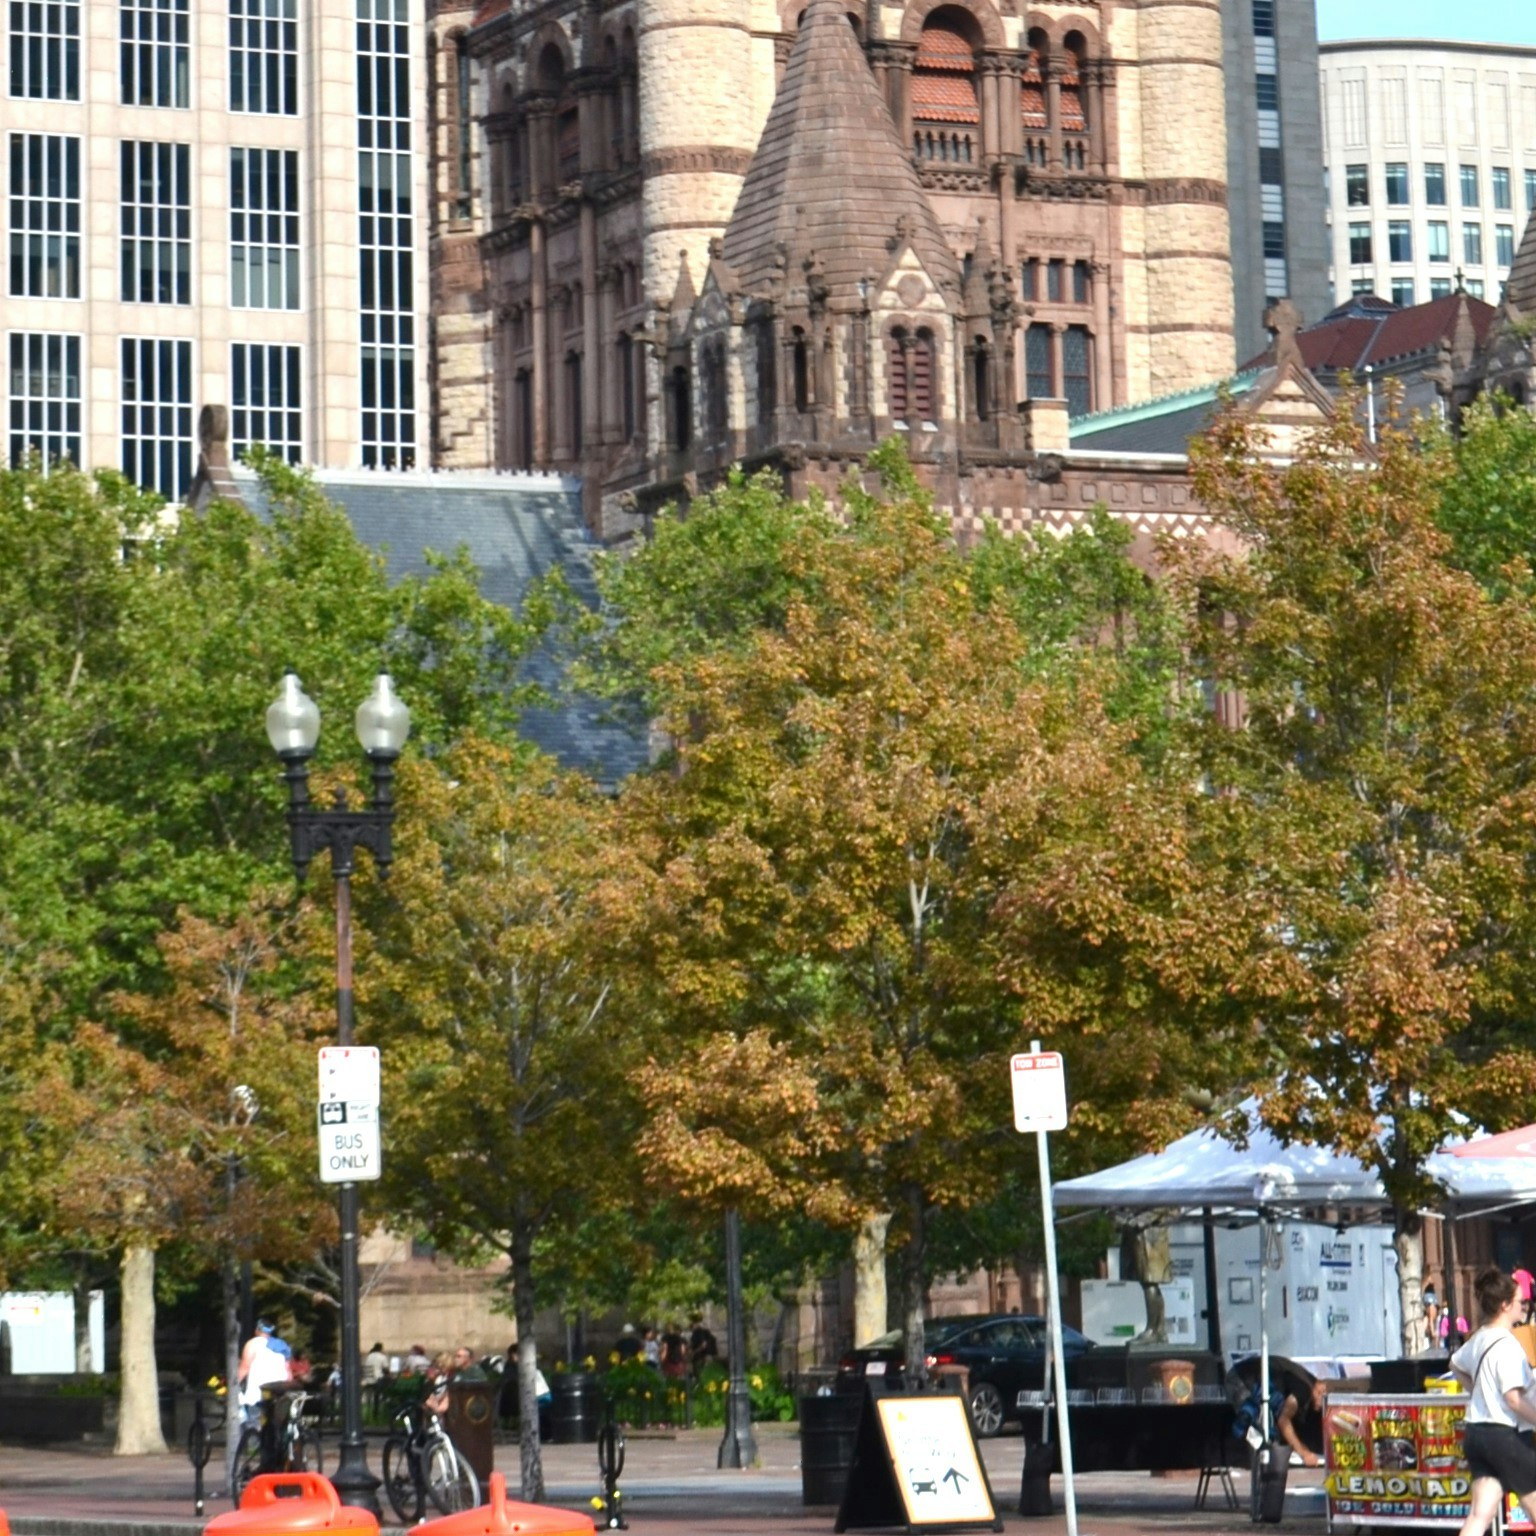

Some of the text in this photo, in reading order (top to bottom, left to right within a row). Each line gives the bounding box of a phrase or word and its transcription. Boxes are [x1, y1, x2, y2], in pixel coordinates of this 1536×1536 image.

[335, 1133, 363, 1150] BUS
[330, 1154, 369, 1170] ONLY
[1336, 1476, 1469, 1499] LEMONAD
